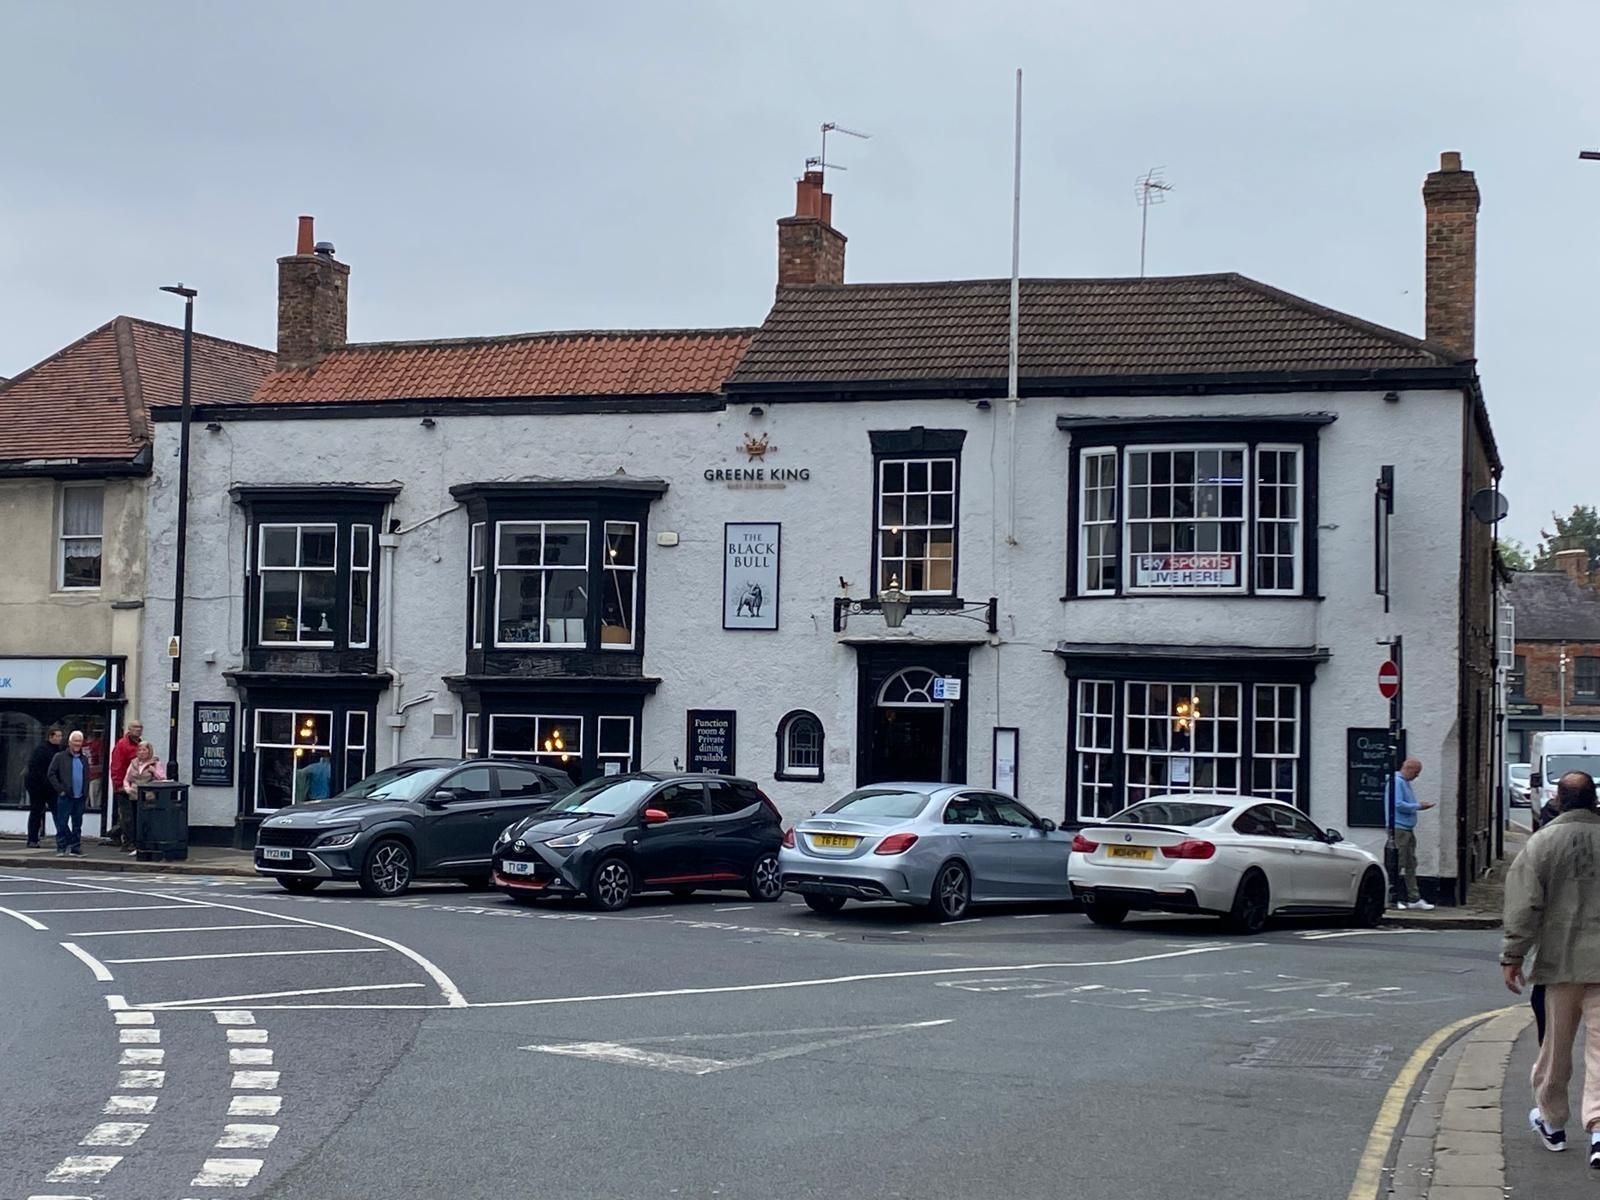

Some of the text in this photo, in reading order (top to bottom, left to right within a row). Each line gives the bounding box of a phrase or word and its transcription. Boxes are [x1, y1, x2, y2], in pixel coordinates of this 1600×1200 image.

[704, 469, 809, 481] GREENE KING
[743, 533, 763, 542] THE
[728, 543, 775, 554] BLACK
[734, 557, 770, 568] BULL
[1170, 557, 1230, 569] SPORTS
[1150, 572, 1221, 582] LIVE HERE
[695, 719, 728, 727] Function
[211, 735, 218, 744] &
[698, 735, 725, 743] Private
[699, 743, 724, 754] dining
[695, 753, 727, 762] available
